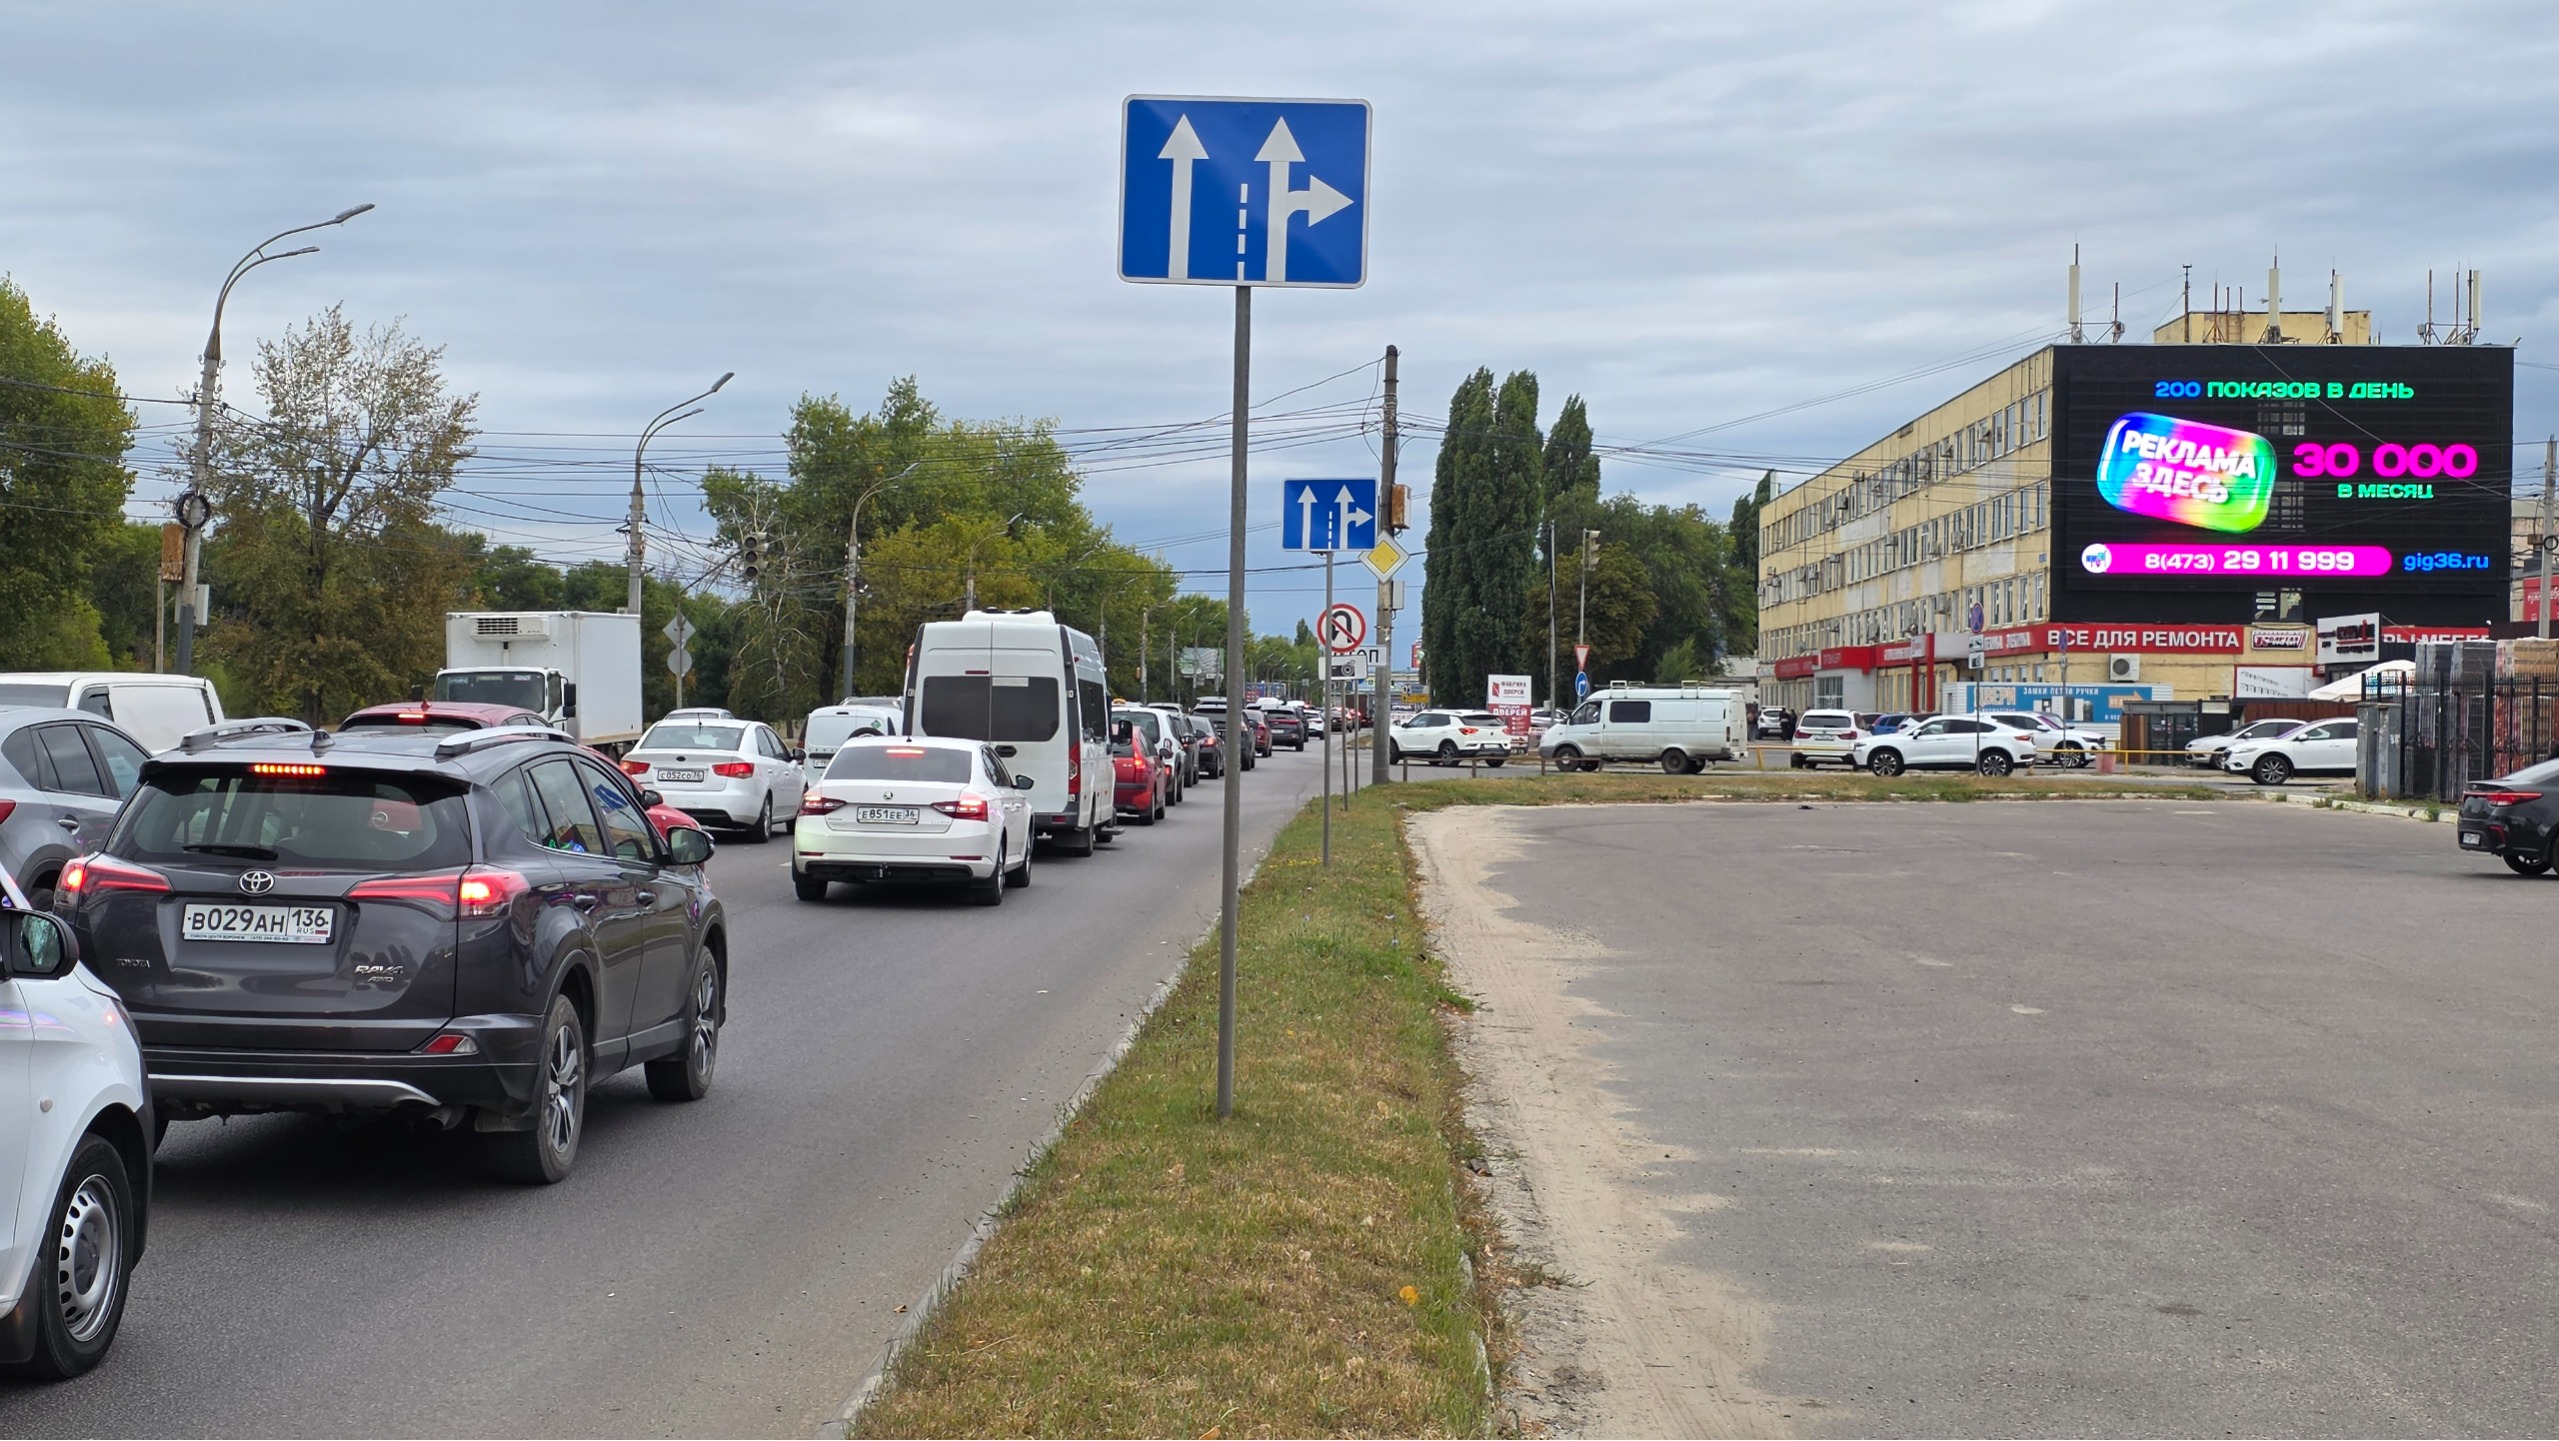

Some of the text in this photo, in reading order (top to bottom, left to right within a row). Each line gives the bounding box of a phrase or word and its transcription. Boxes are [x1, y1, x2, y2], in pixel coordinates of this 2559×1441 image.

[2155, 381, 2414, 399] 200 ПОКАЗОВ В ДЕНЬ
[2122, 429, 2256, 480] РЕКЛАМА
[2293, 443, 2478, 478] 30 000
[2132, 463, 2229, 504] ЗДЕСЬ
[2338, 484, 2434, 500] В МЕСЯЦ
[2145, 551, 2355, 571] 8(473) 29 11 999
[2403, 551, 2489, 571] gig36.ru
[2047, 630, 2089, 646] ВСЕ
[2093, 631, 2137, 649] ДЛЯ
[2142, 632, 2240, 648] РЕМОНТА
[292, 909, 326, 927] 136
